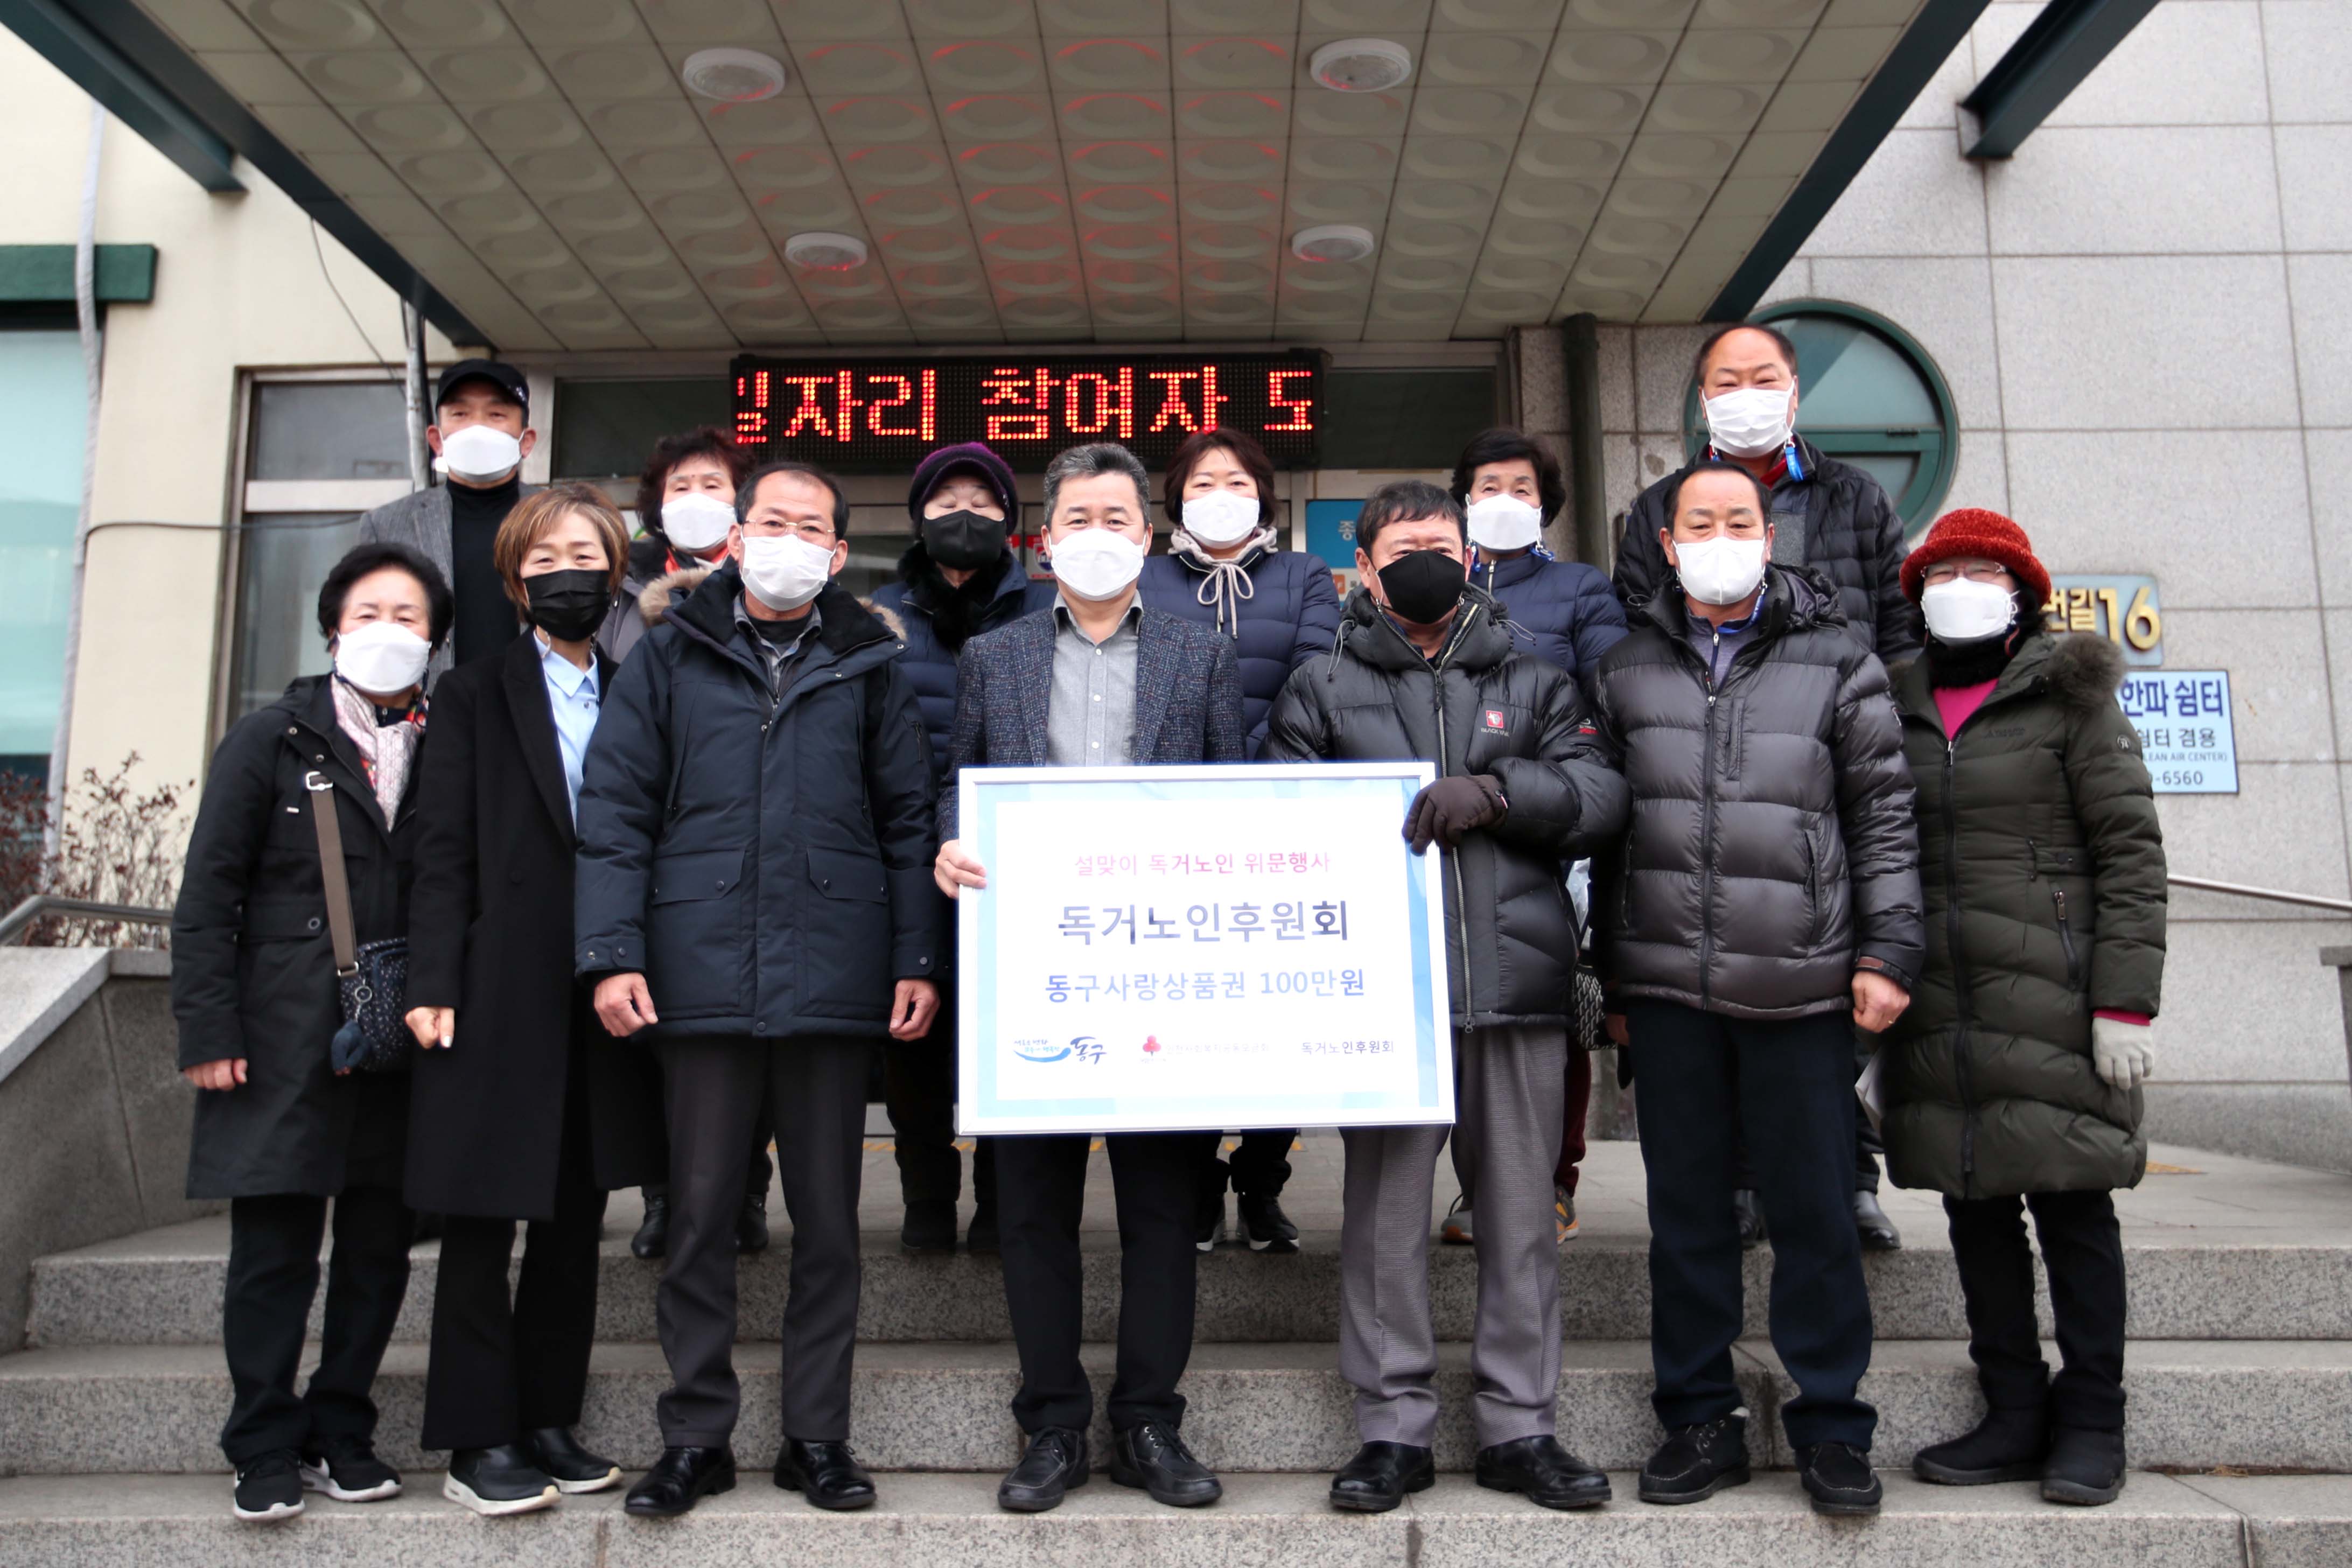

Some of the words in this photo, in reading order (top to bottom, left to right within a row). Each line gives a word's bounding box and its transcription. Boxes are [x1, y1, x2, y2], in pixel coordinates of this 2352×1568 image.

[982, 366, 1228, 439] 참여자
[2120, 680, 2169, 717] 한파
[2174, 679, 2224, 717] 쉼터
[2178, 727, 2216, 748] 겸용
[2170, 752, 2186, 762] AIR
[1074, 853, 1138, 877] 설맞이
[1148, 852, 1234, 875] 독거노인
[1244, 851, 1331, 874] 위문행사
[1057, 900, 1348, 946] 독거노인후원회
[1045, 971, 1246, 1003] 동구사랑상품권
[1259, 968, 1365, 998] 100만원
[1069, 1035, 1108, 1065] 동구
[1301, 1040, 1394, 1054] 독거노인후원회
